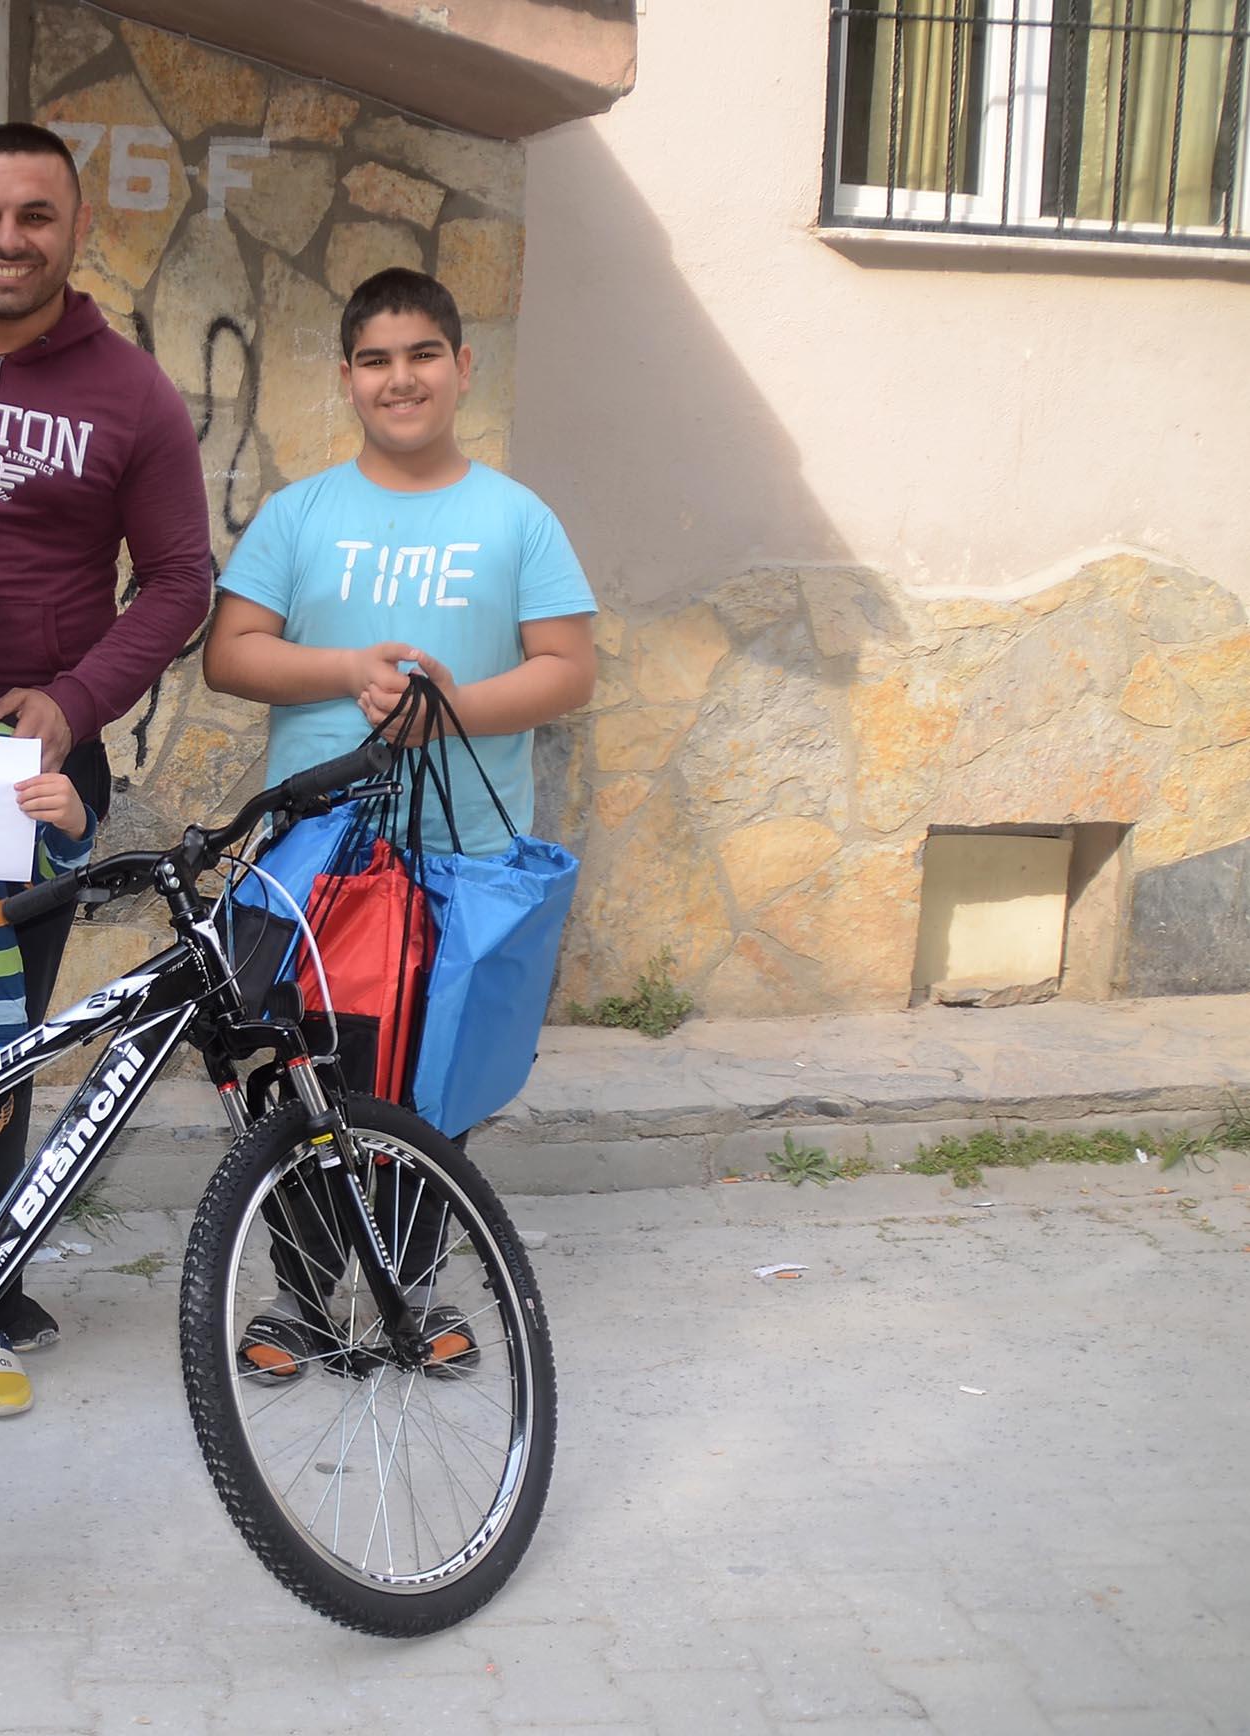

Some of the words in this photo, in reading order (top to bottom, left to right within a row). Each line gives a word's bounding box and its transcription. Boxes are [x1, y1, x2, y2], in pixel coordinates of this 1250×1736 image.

[5, 449, 56, 476] ATHLETICS
[335, 540, 481, 607] TIME
[10, 1041, 145, 1230] Bianchi
